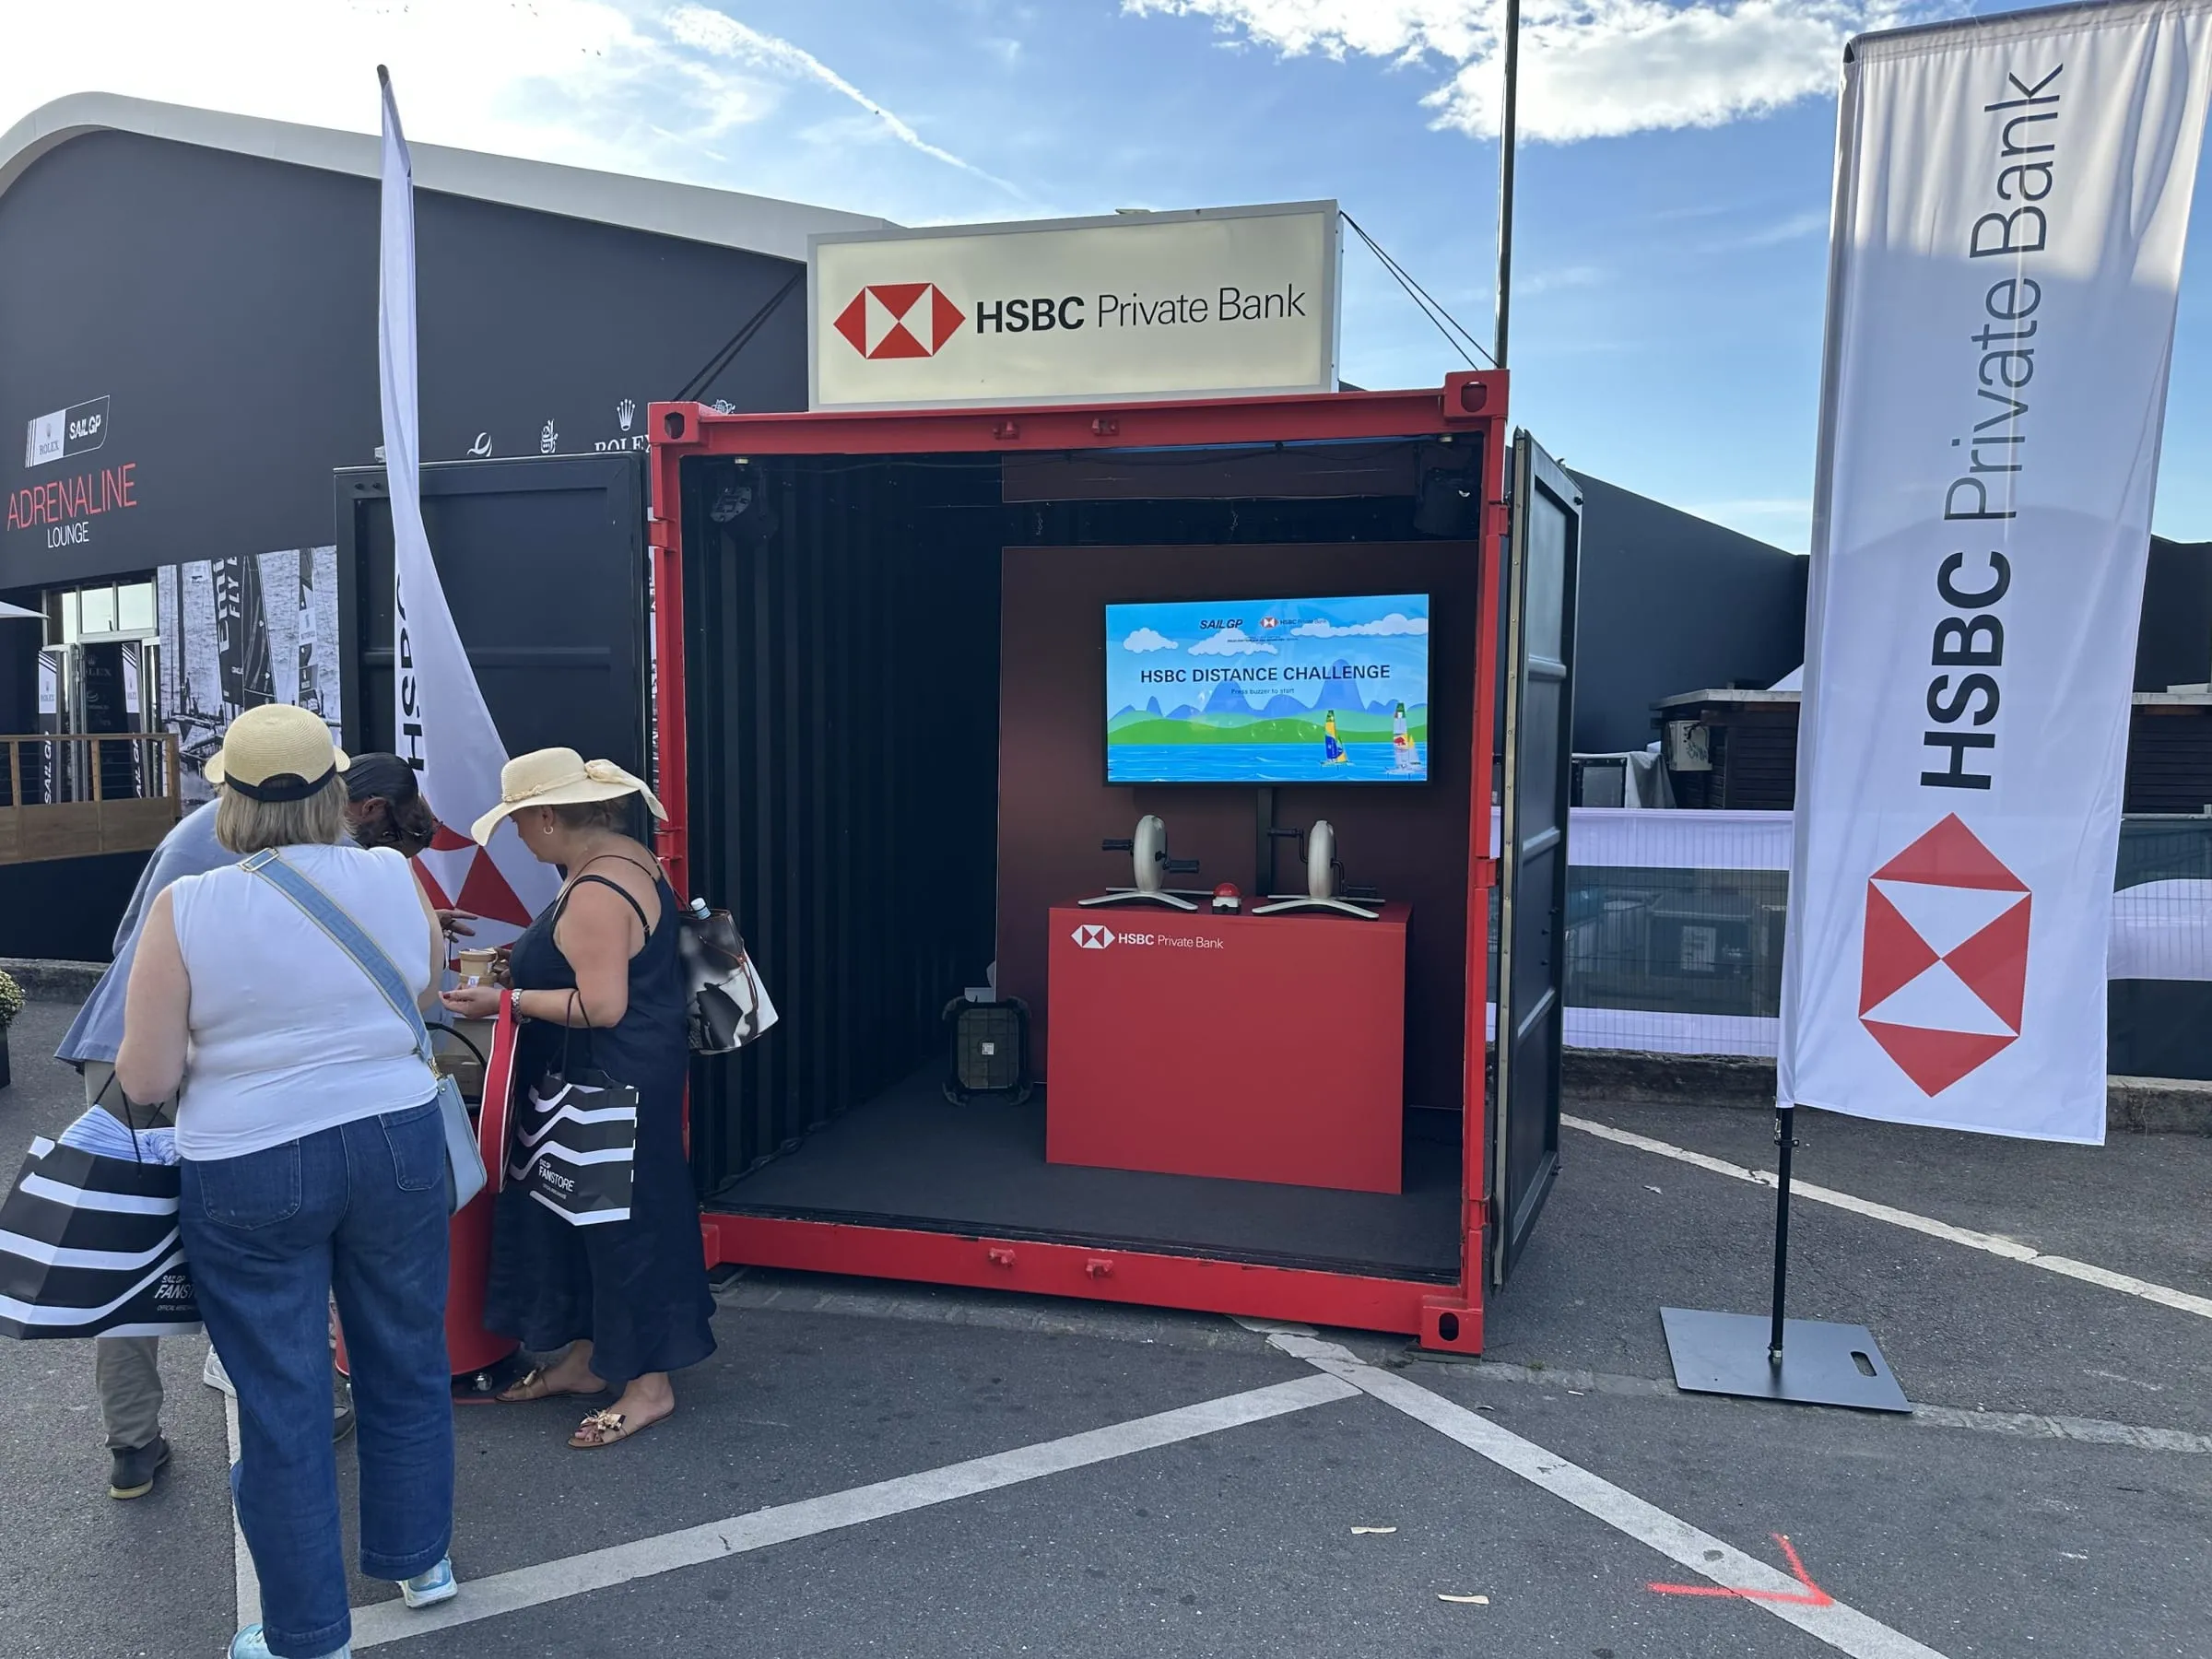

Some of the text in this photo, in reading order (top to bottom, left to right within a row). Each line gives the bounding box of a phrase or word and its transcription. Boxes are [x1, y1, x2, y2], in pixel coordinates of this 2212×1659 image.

[976, 283, 1307, 334] HSBC Private Bank
[1920, 63, 2064, 790] HSBC Private Bank
[39, 440, 60, 455] ROLEX
[7, 463, 136, 532] ADRENALINE
[47, 521, 89, 548] LOUNGE
[1141, 665, 1391, 683] HSBC DISTANCE CHALLENGE
[1118, 933, 1224, 948] HSBC Private Bank
[538, 1166, 575, 1192] FANSTORE
